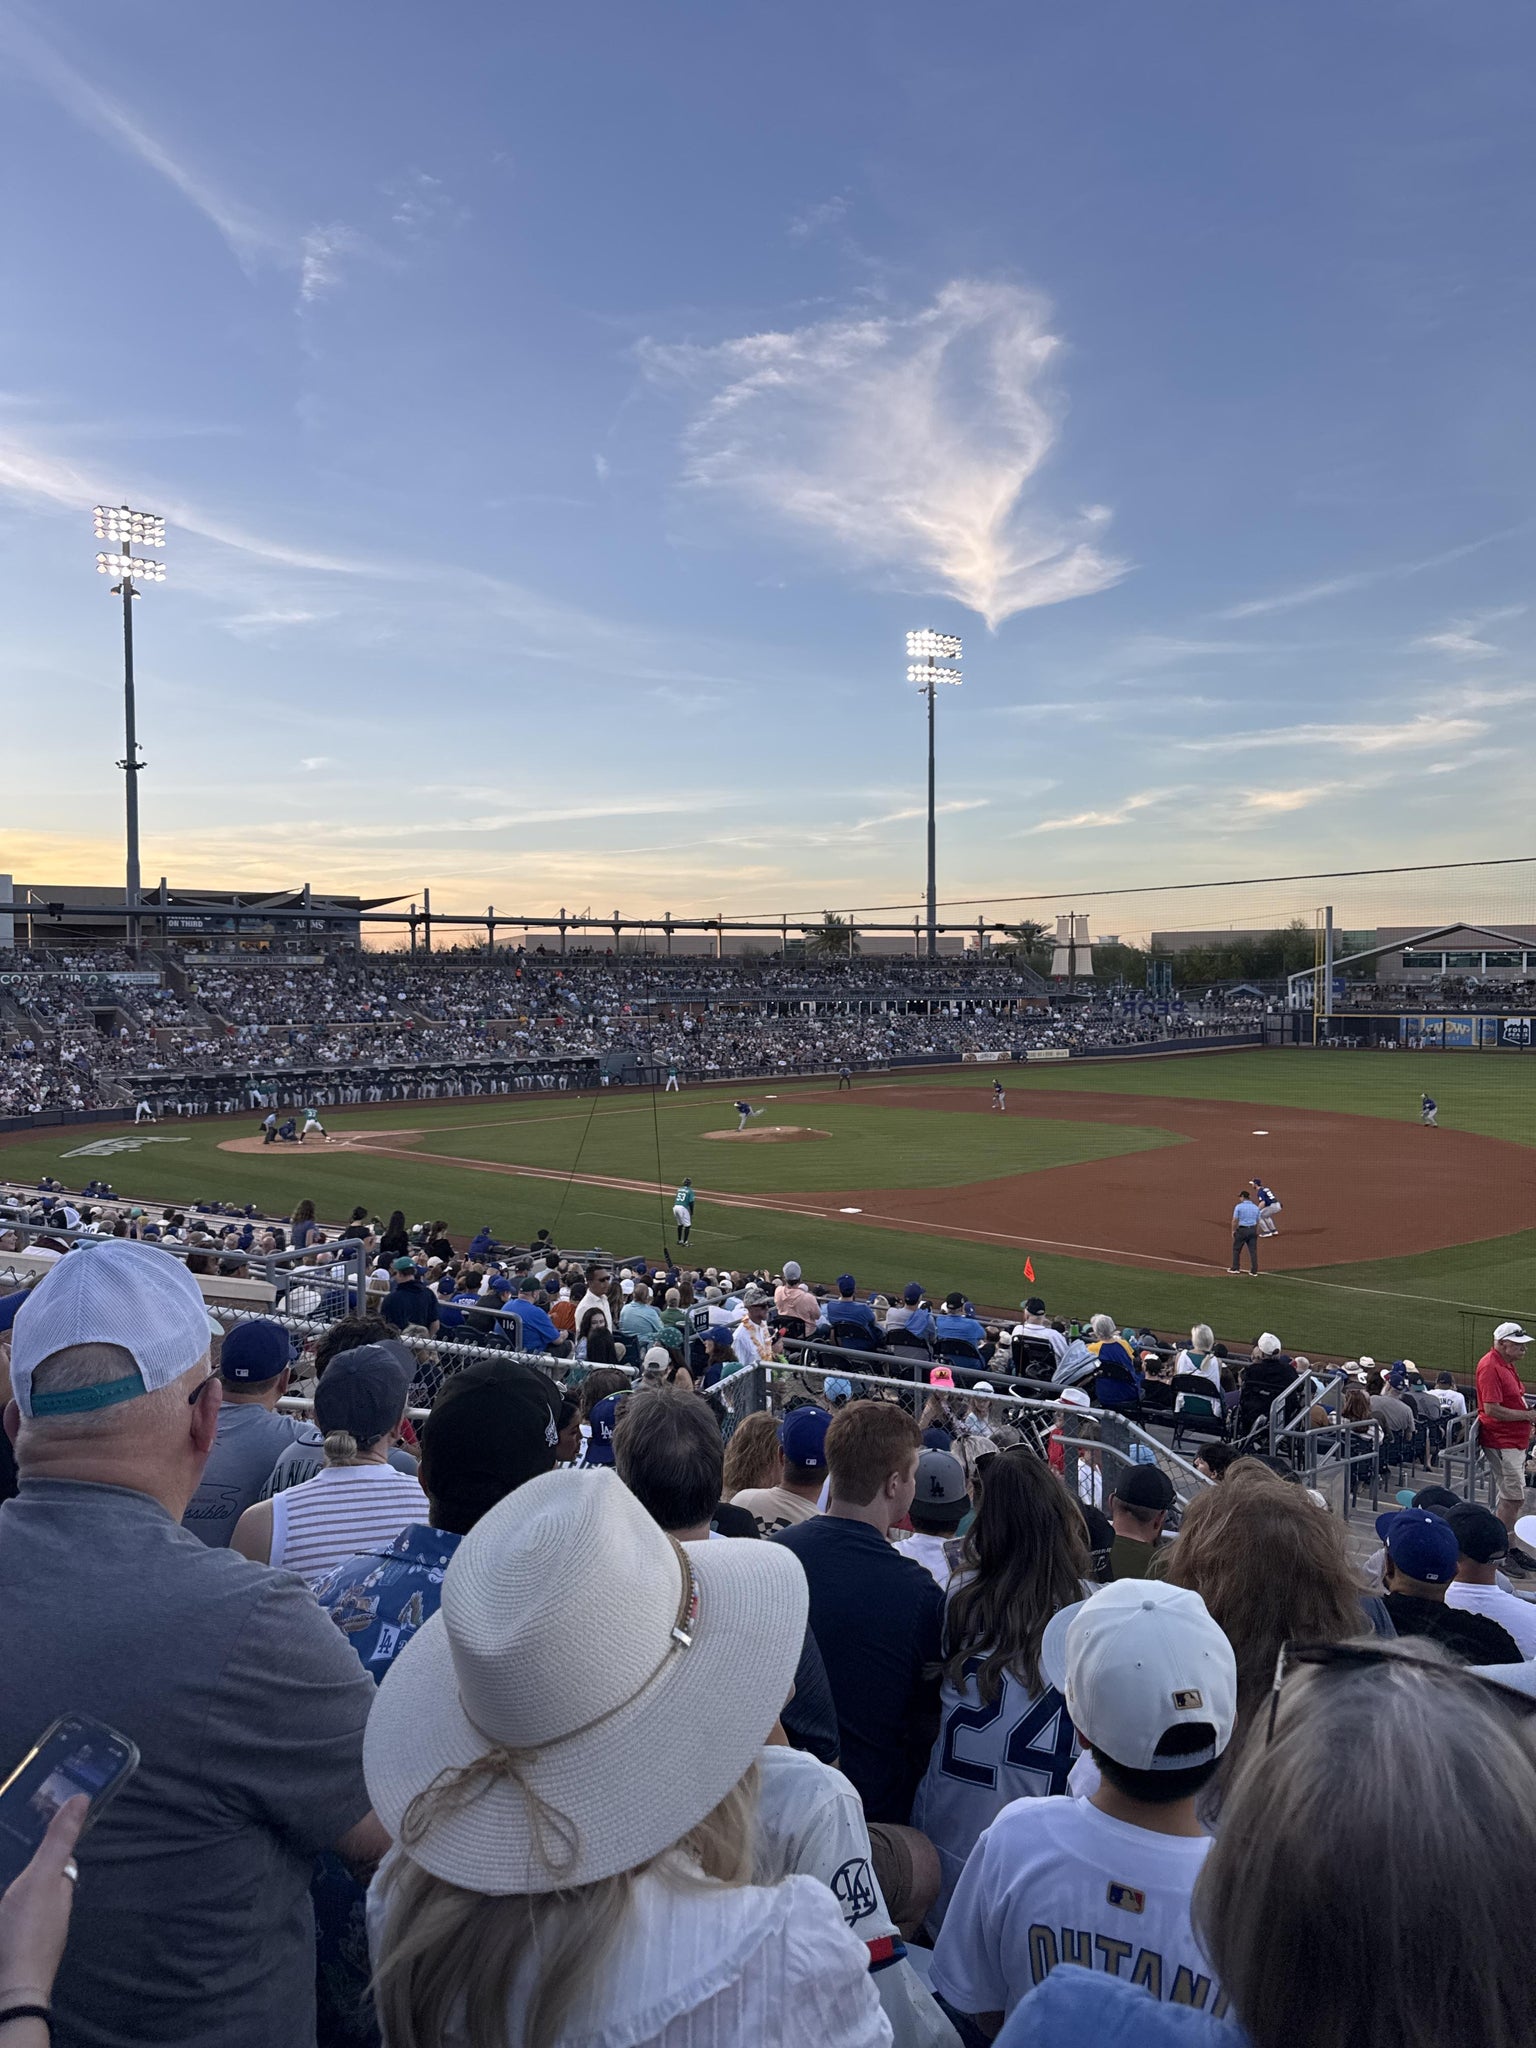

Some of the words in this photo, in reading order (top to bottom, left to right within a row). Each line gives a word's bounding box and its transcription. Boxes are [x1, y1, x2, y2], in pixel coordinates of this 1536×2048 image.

[181, 920, 203, 928] THIRD
[676, 1192, 686, 1201] 53
[502, 1319, 515, 1331] 116
[696, 1314, 707, 1326] 118
[600, 1421, 613, 1439] LA
[930, 1475, 945, 1497] LA
[377, 1628, 393, 1654] LA
[940, 1655, 1078, 1797] 24
